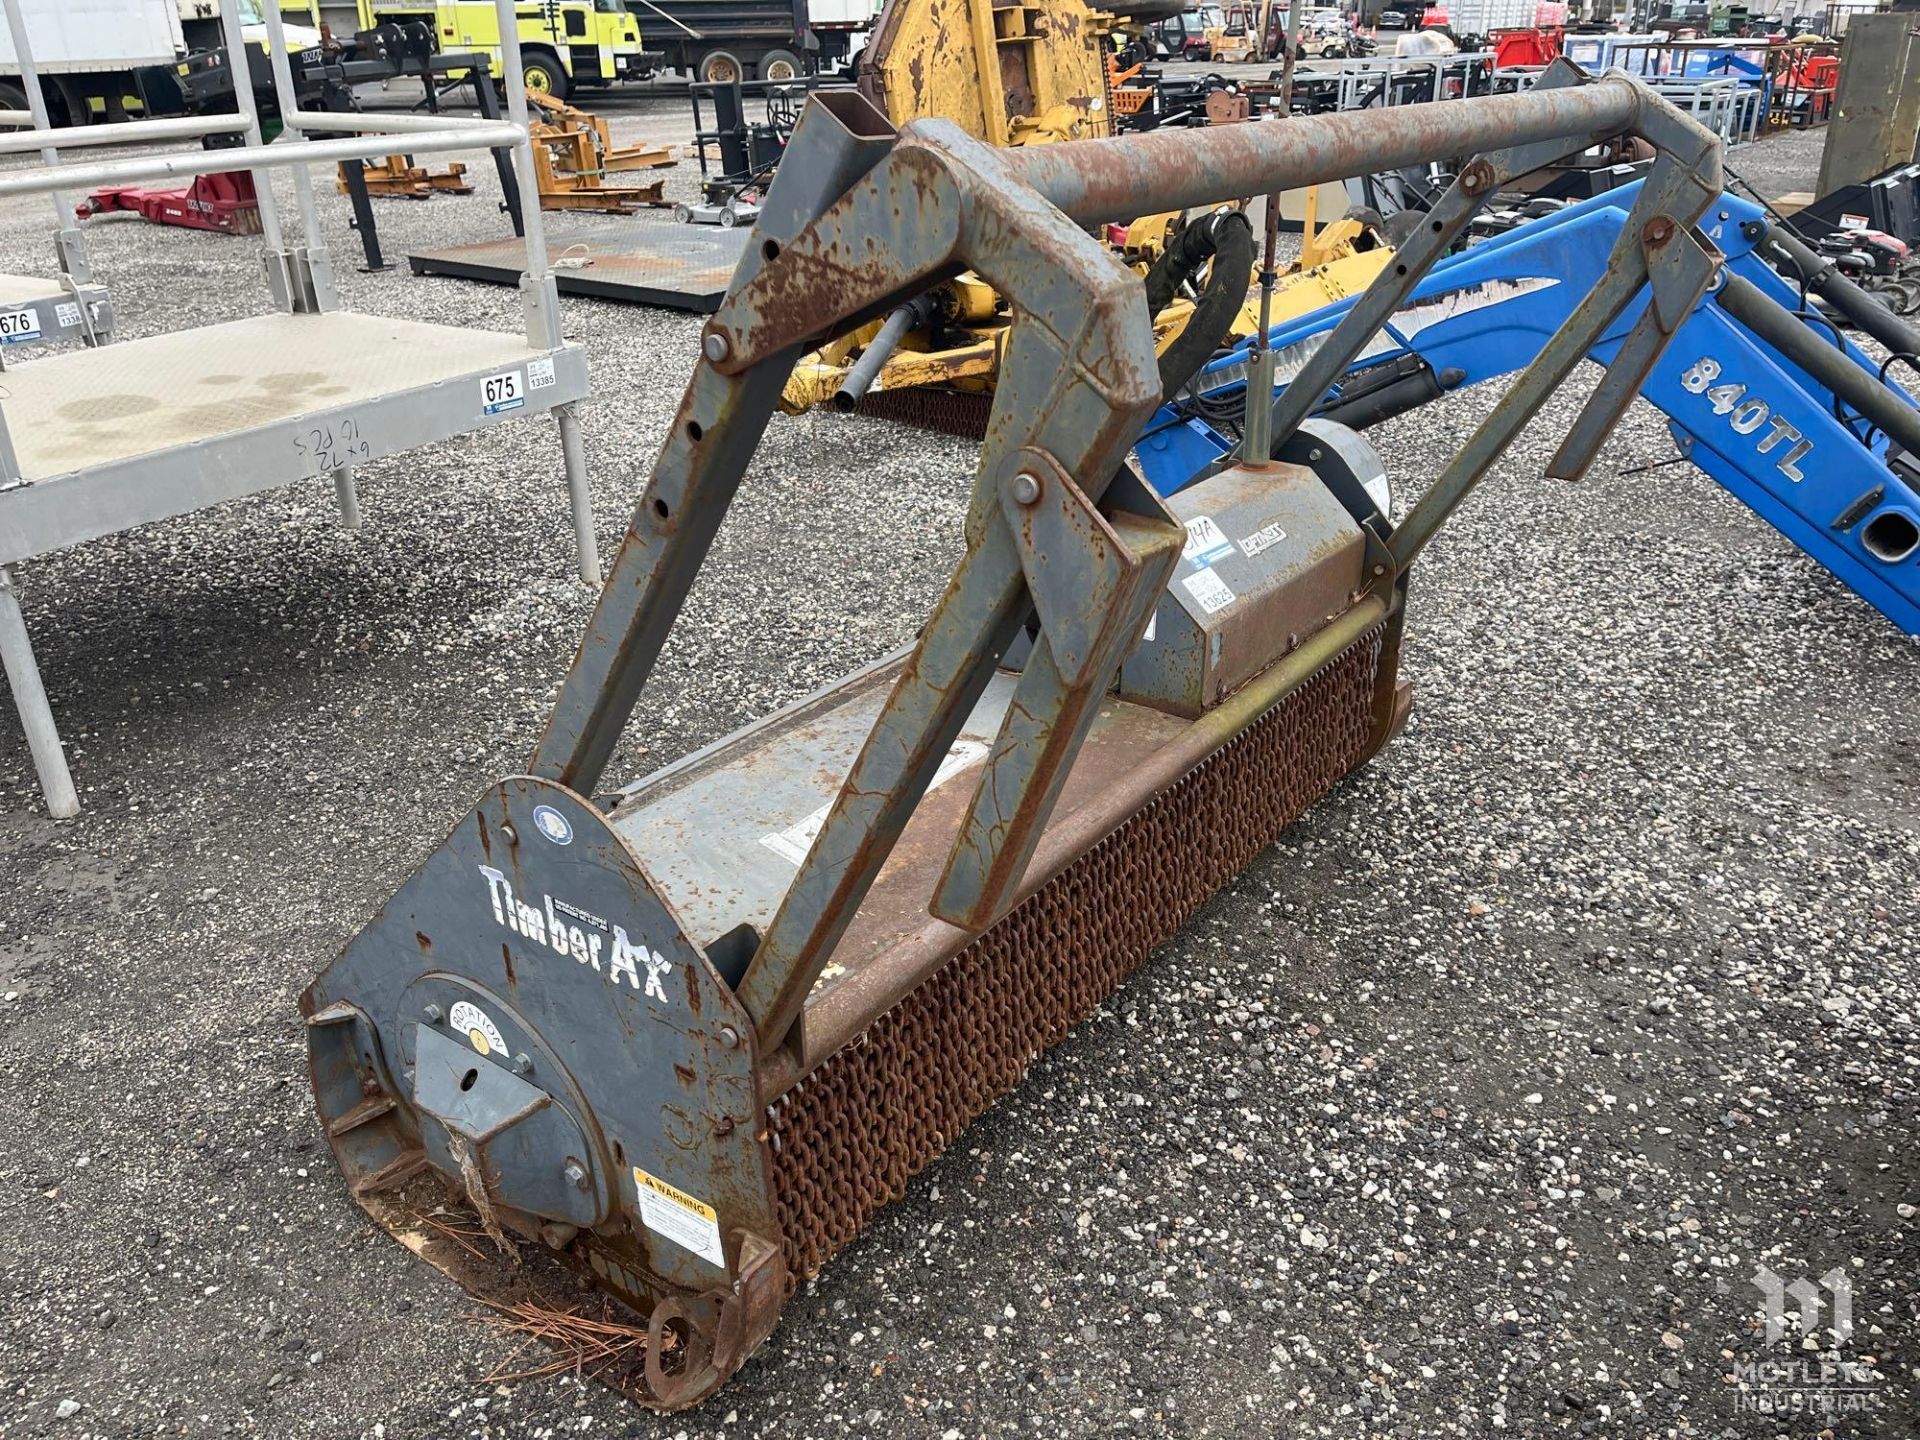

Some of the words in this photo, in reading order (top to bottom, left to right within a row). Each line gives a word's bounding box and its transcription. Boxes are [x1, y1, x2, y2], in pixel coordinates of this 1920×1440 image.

[0, 313, 31, 334] 676
[486, 376, 515, 402] 675
[531, 375, 555, 388] 13385
[1681, 357, 1814, 482] 840TL
[1203, 588, 1234, 611] 13625
[453, 1005, 504, 1047] ROTATION
[656, 1182, 706, 1216] WARNING
